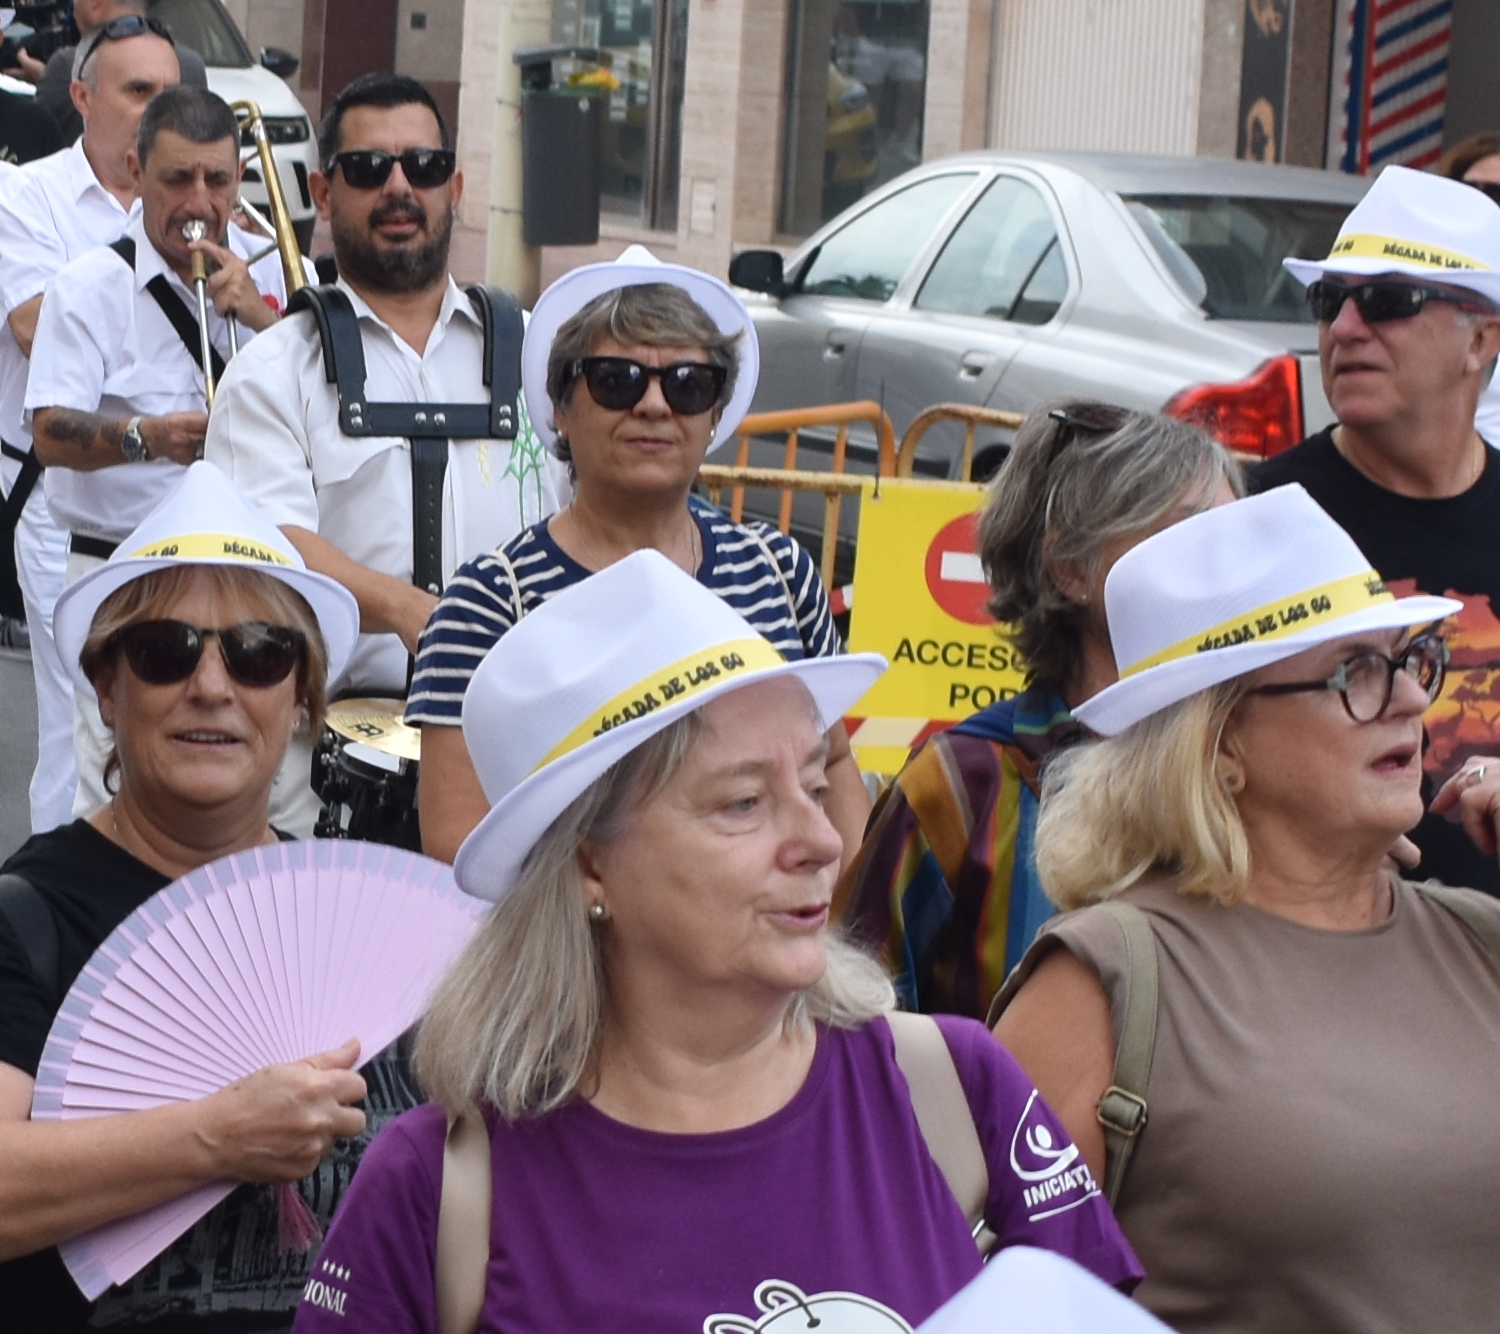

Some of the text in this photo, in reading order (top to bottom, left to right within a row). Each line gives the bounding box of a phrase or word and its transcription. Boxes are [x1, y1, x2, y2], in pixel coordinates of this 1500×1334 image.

[1255, 613, 1278, 636] DE
[1278, 602, 1309, 627] LOS
[658, 676, 687, 701] DE
[684, 661, 721, 687] LOS
